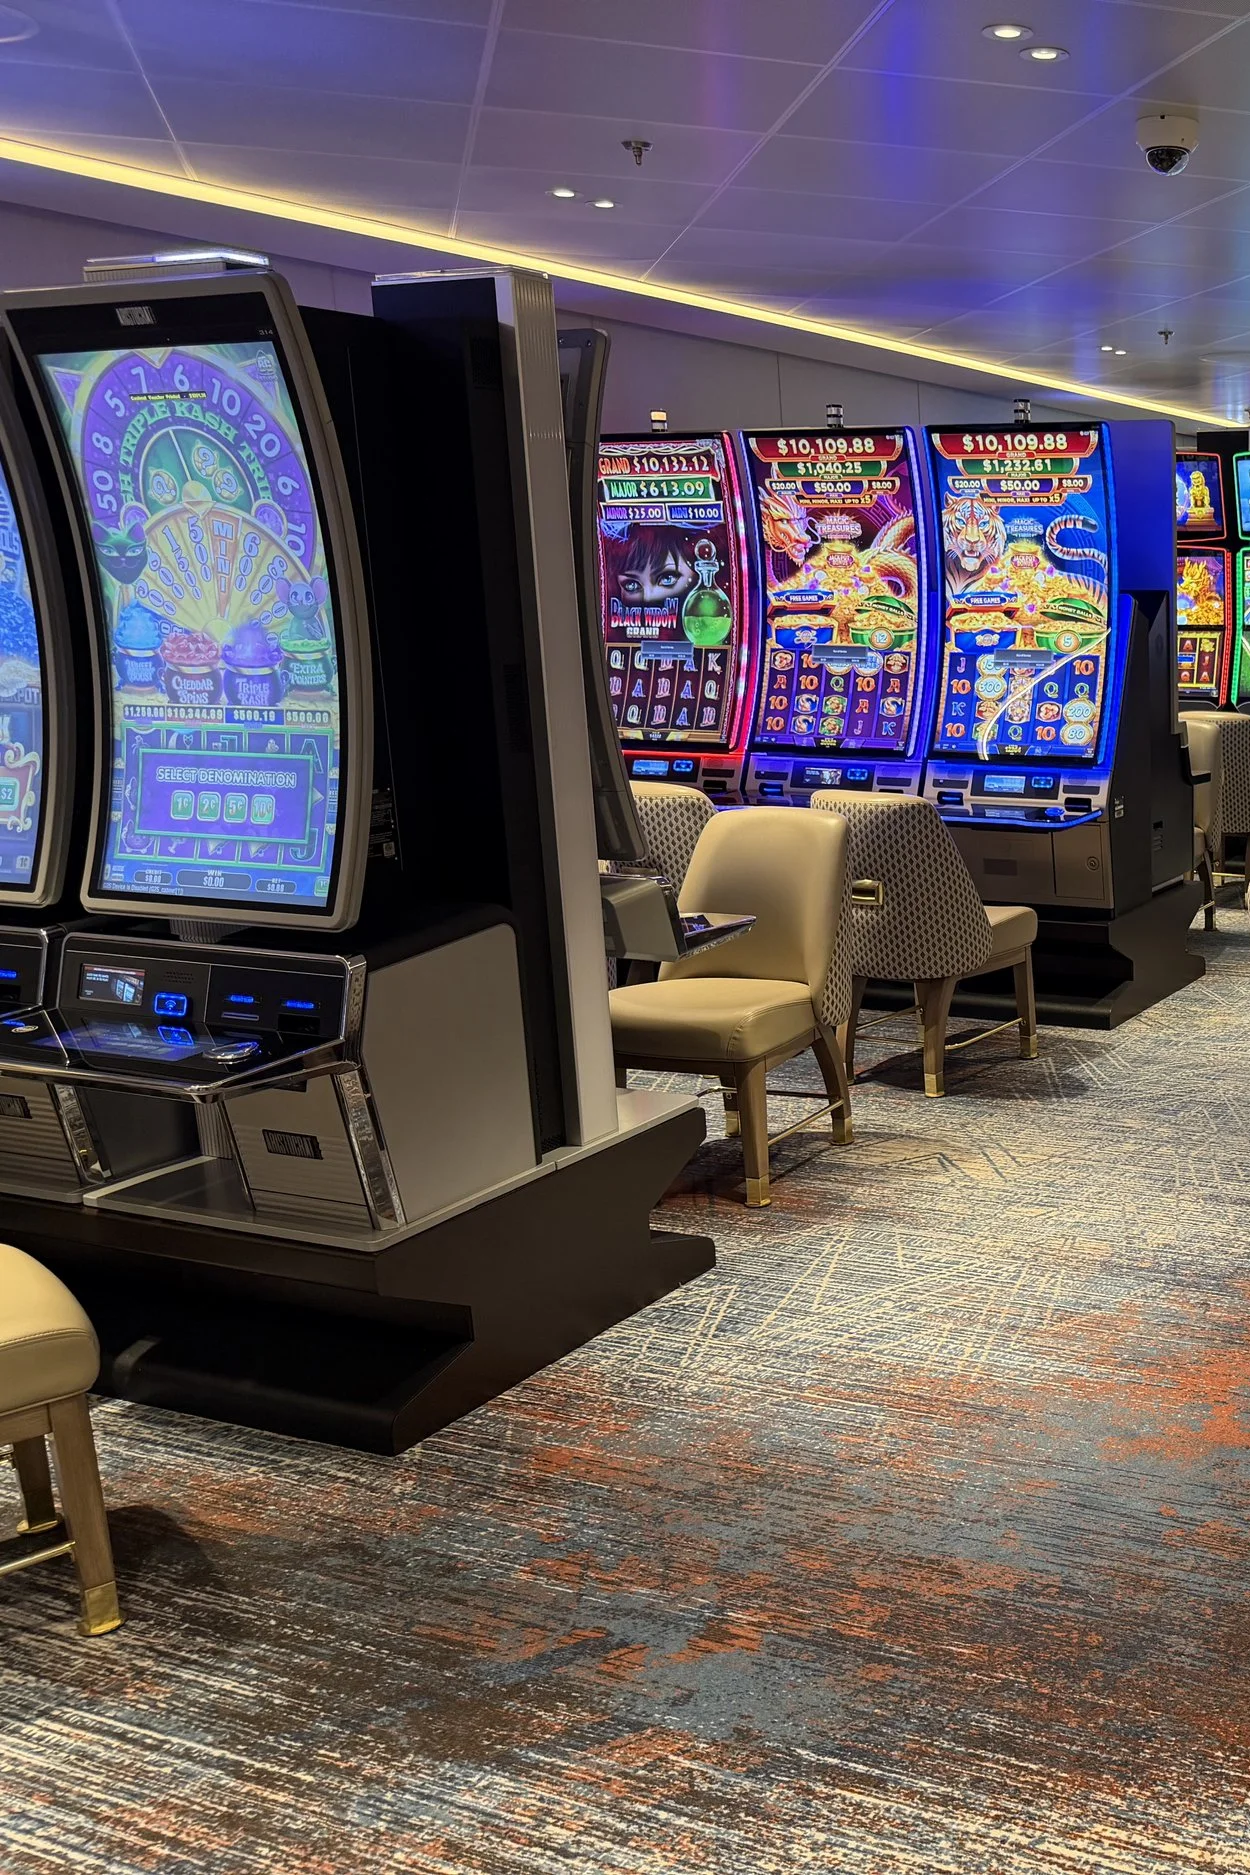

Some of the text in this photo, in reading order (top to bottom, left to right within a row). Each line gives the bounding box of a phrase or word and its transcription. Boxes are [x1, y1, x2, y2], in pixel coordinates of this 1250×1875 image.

[258, 329, 274, 337] 314
[175, 400, 238, 444] KASH
[777, 437, 875, 456] $10,109.88
[962, 434, 1068, 452] $10,109.88
[599, 455, 710, 474] GRAND $10,132.12
[797, 462, 862, 475] $1,040.25
[983, 459, 1052, 473] $1,232.61
[610, 481, 704, 498] MAJOR $613.09
[772, 482, 796, 491] $20.00
[814, 482, 851, 493] $50.00
[1000, 480, 1040, 492] $50.00
[628, 507, 661, 519] $25.00
[688, 507, 719, 519] $10.00
[816, 523, 860, 533] TREASURES
[1006, 524, 1043, 532] TREASURES
[212, 519, 233, 593] MINI
[290, 661, 324, 674] EXTRA
[172, 676, 214, 691] CHEDDAR
[235, 678, 270, 693] TRIPLE
[177, 690, 209, 704] SPINS
[156, 766, 298, 788] SELECT DENOMINATION
[203, 876, 225, 887] $0.00
